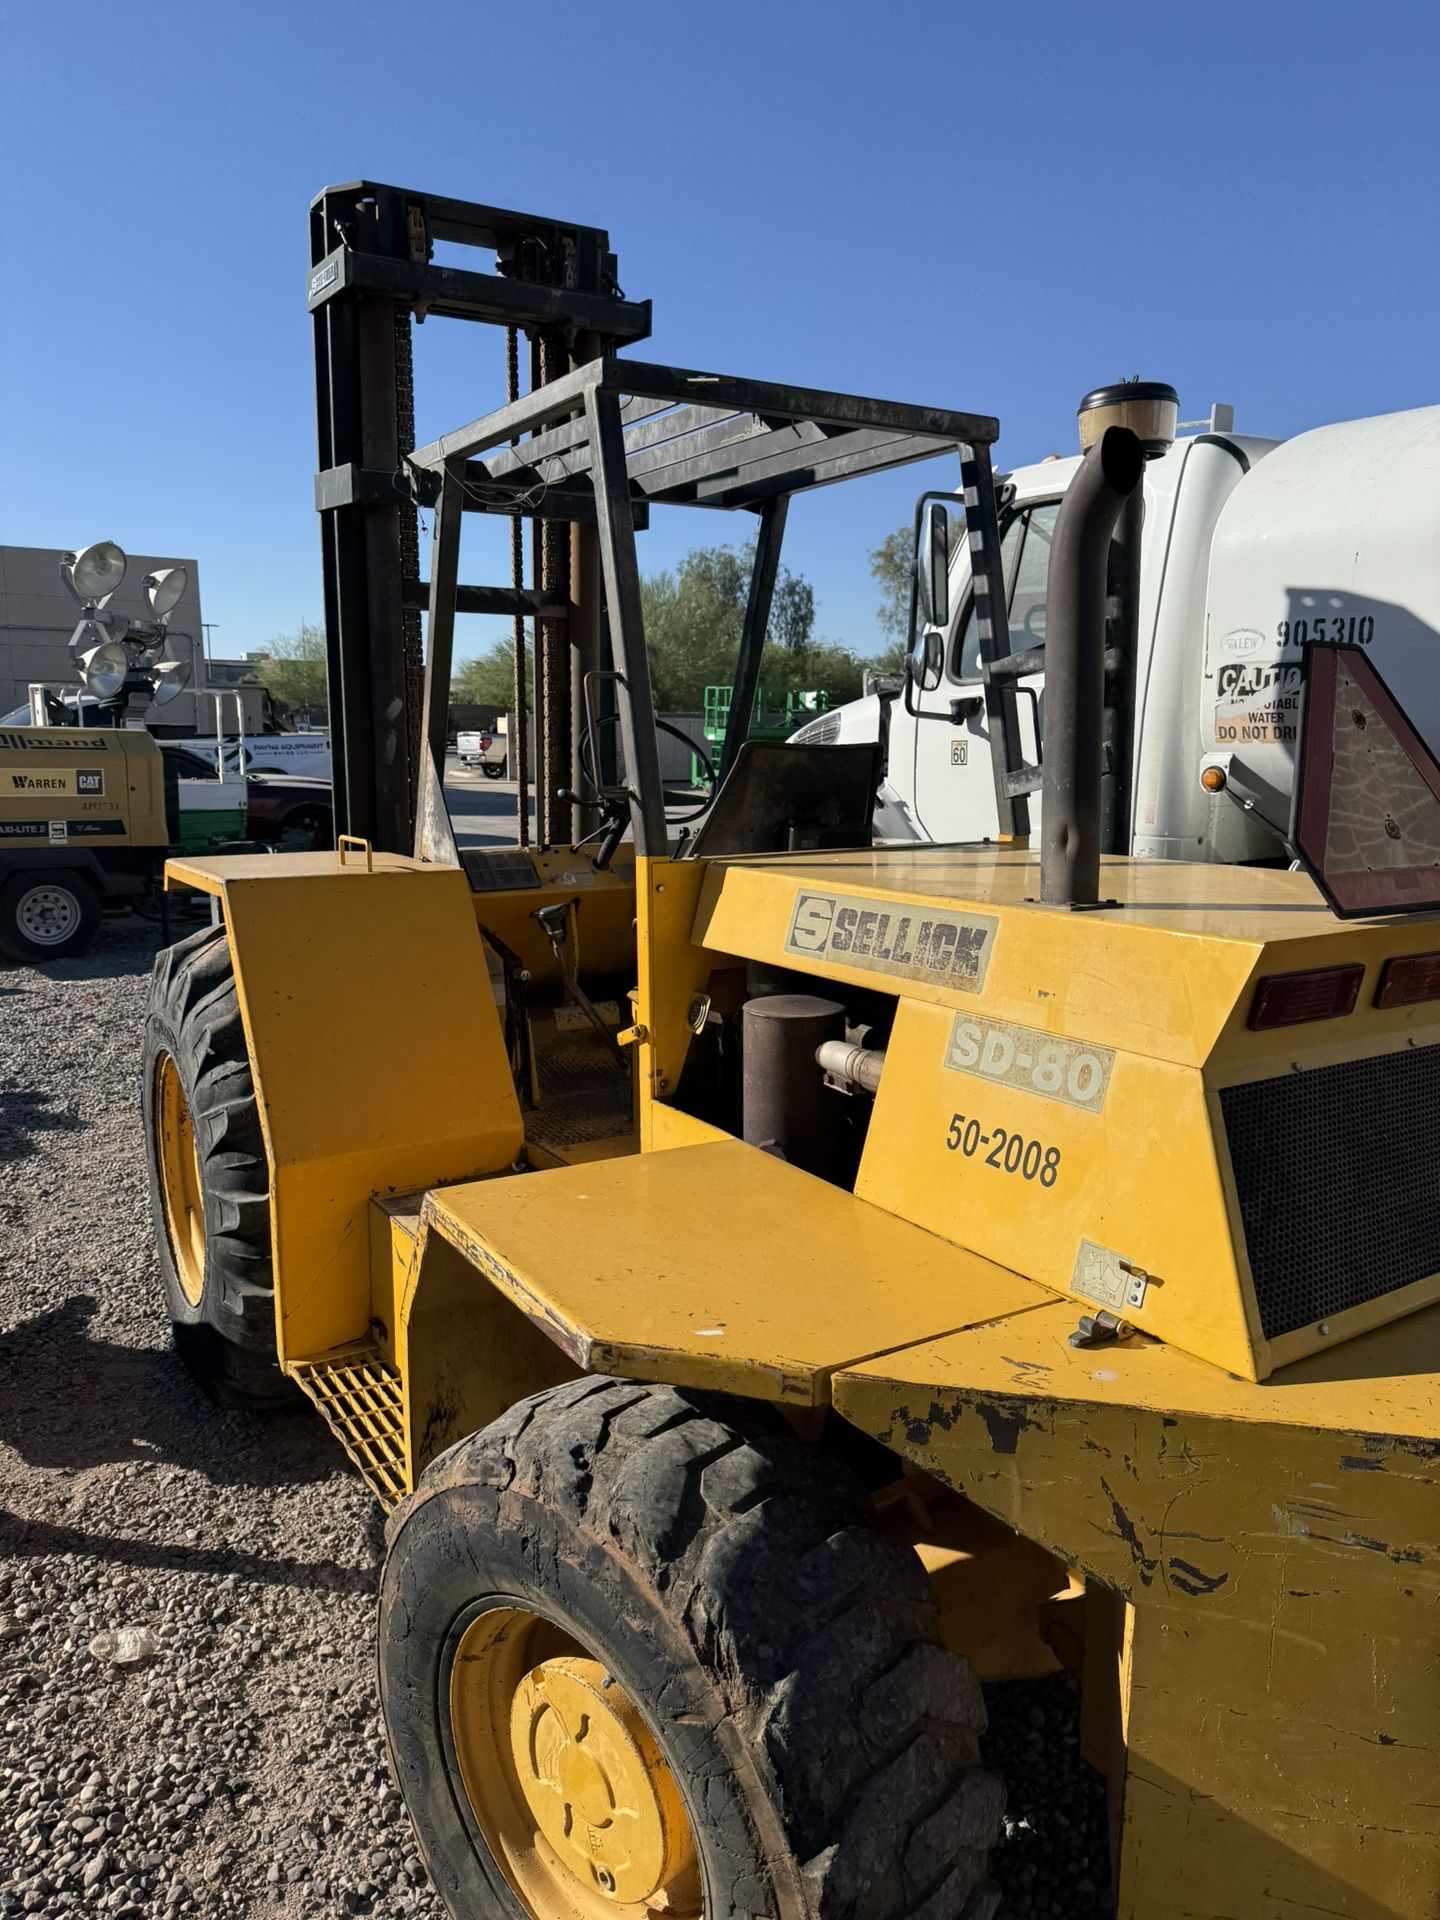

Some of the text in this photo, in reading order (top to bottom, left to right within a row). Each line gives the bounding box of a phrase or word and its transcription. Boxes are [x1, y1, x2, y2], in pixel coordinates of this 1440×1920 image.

[1276, 616, 1374, 647] 905310
[1221, 667, 1303, 693] CAUTIO
[1248, 712, 1285, 724] WATER
[1219, 726, 1297, 740] DO NOT DRI
[953, 747, 966, 763] 60
[12, 776, 101, 789] WARREN CAT
[831, 908, 988, 977] SELLICK
[950, 1022, 1104, 1101] SD-80
[946, 1113, 1061, 1187] 50-2008
